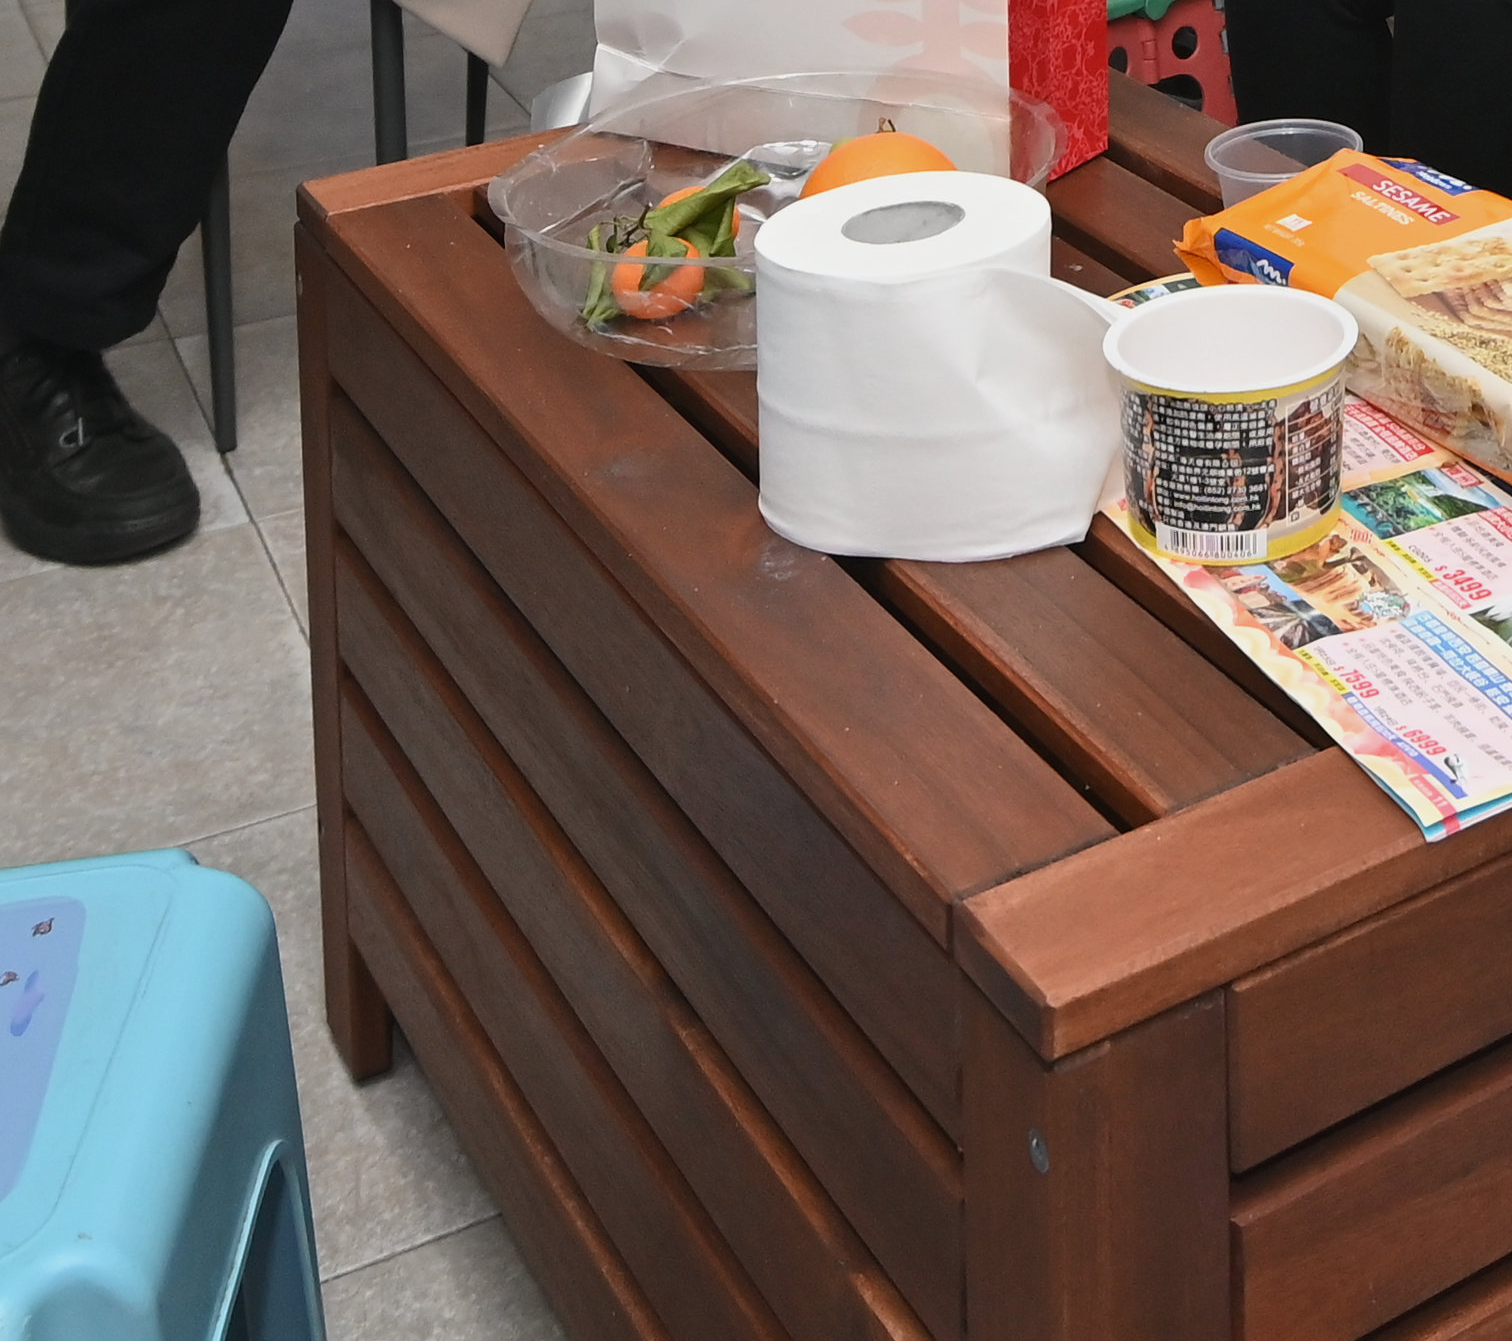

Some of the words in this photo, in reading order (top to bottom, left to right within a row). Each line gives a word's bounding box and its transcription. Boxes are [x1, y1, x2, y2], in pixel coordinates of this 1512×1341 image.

[1351, 191, 1415, 225] SALTINES
[1372, 180, 1451, 222] SESAME
[1204, 486, 1225, 496] (852)
[1442, 568, 1492, 601] 3499
[1339, 668, 1380, 699] 7599
[1402, 728, 1447, 756] 6999
